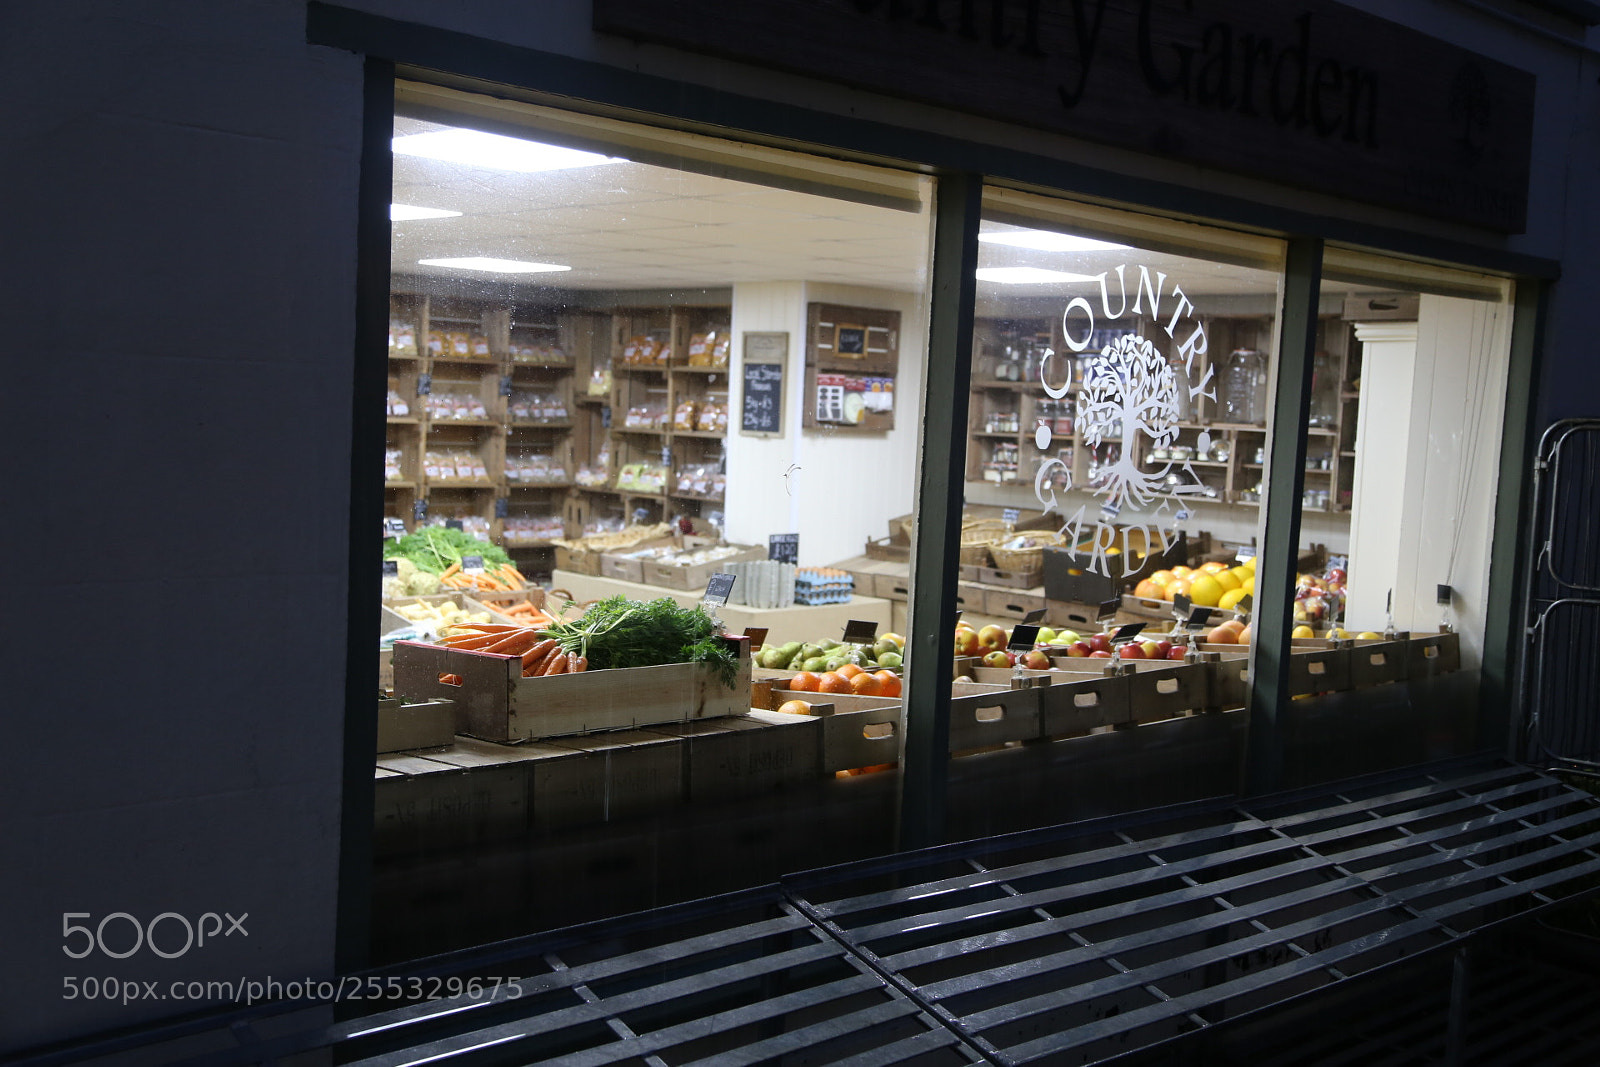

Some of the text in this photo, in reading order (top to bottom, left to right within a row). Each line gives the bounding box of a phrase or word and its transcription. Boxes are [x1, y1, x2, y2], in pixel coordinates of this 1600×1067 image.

[1137, 0, 1380, 149] Garden
[1040, 264, 1218, 404] COUNTRY
[1034, 457, 1205, 579] GARDEN
